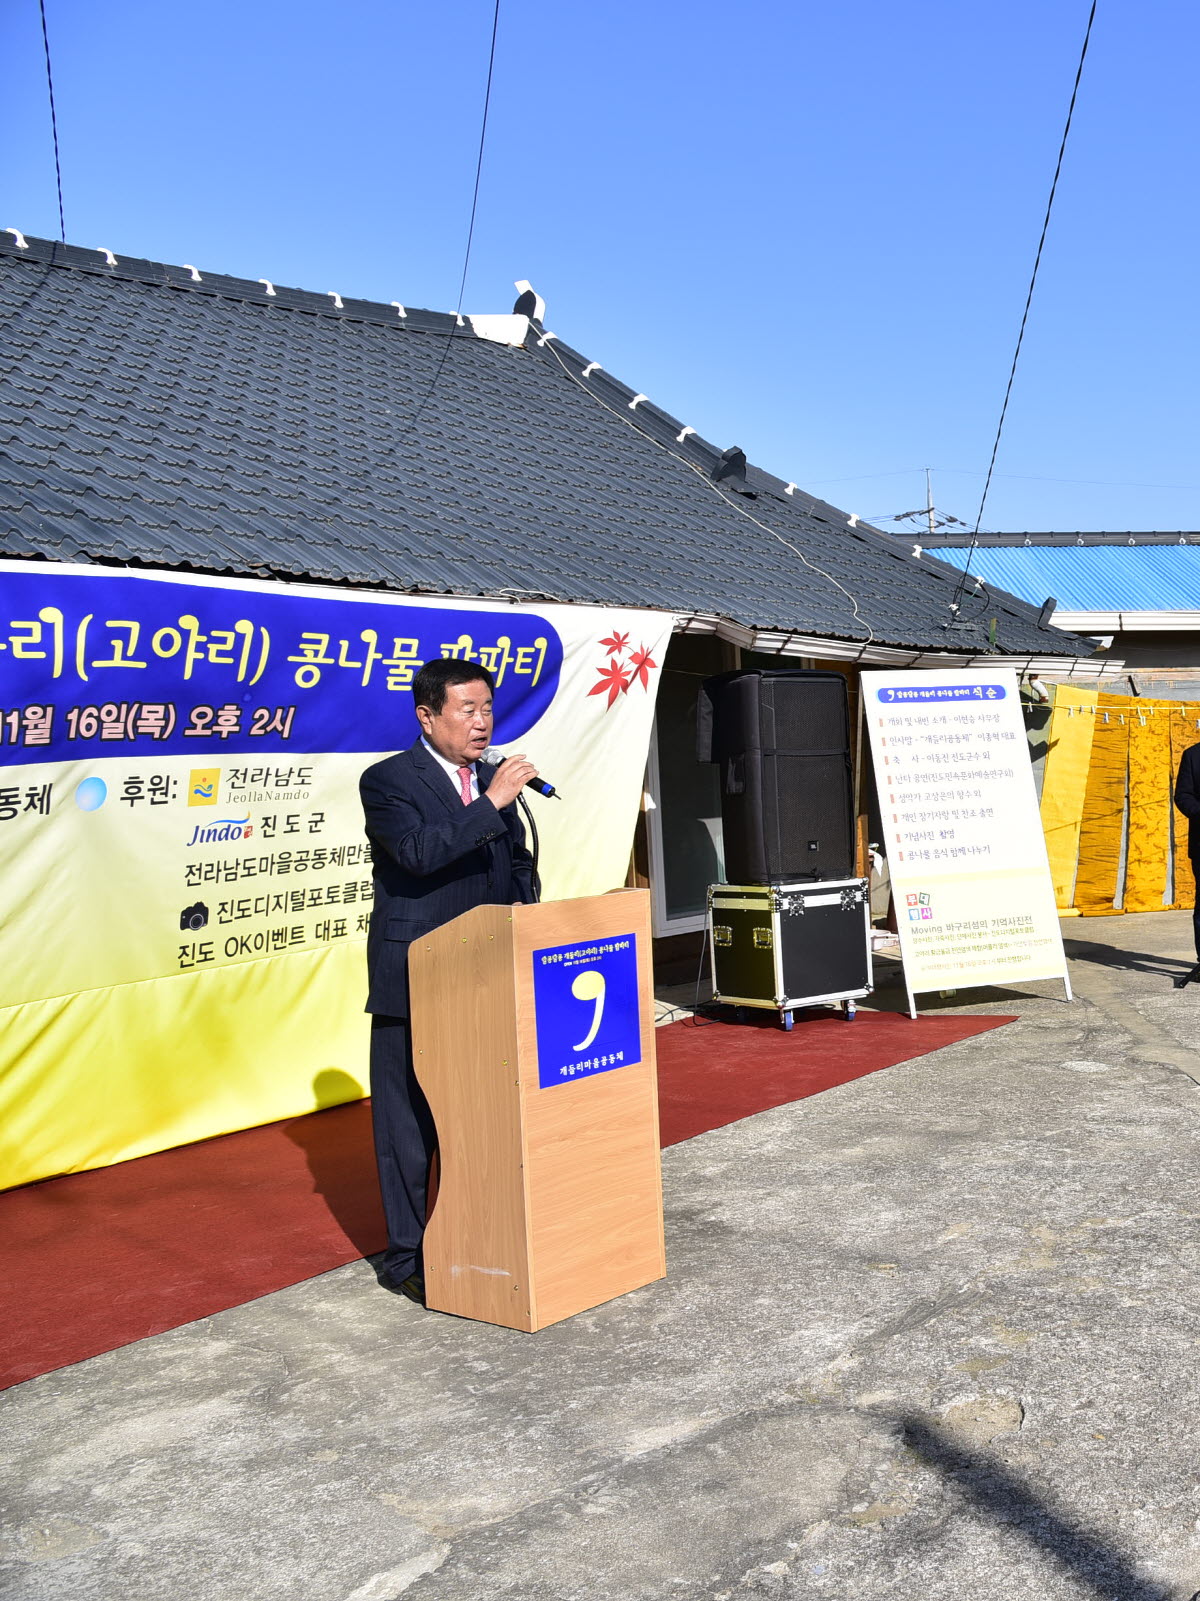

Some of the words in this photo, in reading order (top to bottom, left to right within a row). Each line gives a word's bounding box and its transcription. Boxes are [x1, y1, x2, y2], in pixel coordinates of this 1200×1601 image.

[0, 606, 271, 687] 리(고야리)
[287, 629, 424, 691] 콩나물
[0, 703, 54, 747] 1월
[64, 702, 178, 743] 16일(목)
[183, 703, 242, 741] 오후
[248, 705, 297, 741] 2시
[914, 716, 929, 726] 내빈
[932, 716, 947, 724] 소개
[1001, 732, 1016, 740] 대표
[926, 753, 949, 763] 이동진
[951, 752, 981, 762] 진도군수
[225, 766, 314, 789] 전라남도
[120, 774, 178, 808] 후원:
[226, 790, 310, 804] JeollaNamdo
[899, 793, 921, 804] 성악가
[901, 812, 917, 823] 개인
[919, 810, 949, 822] 장기자랑
[904, 830, 935, 842] 기념사진
[933, 848, 948, 859] 음식
[967, 844, 991, 855] 나누기
[911, 925, 943, 935] Moving
[991, 915, 1033, 928] 기억사진전
[177, 940, 215, 969] 진도
[224, 924, 306, 958] OK이벤트
[315, 916, 348, 942] 대표
